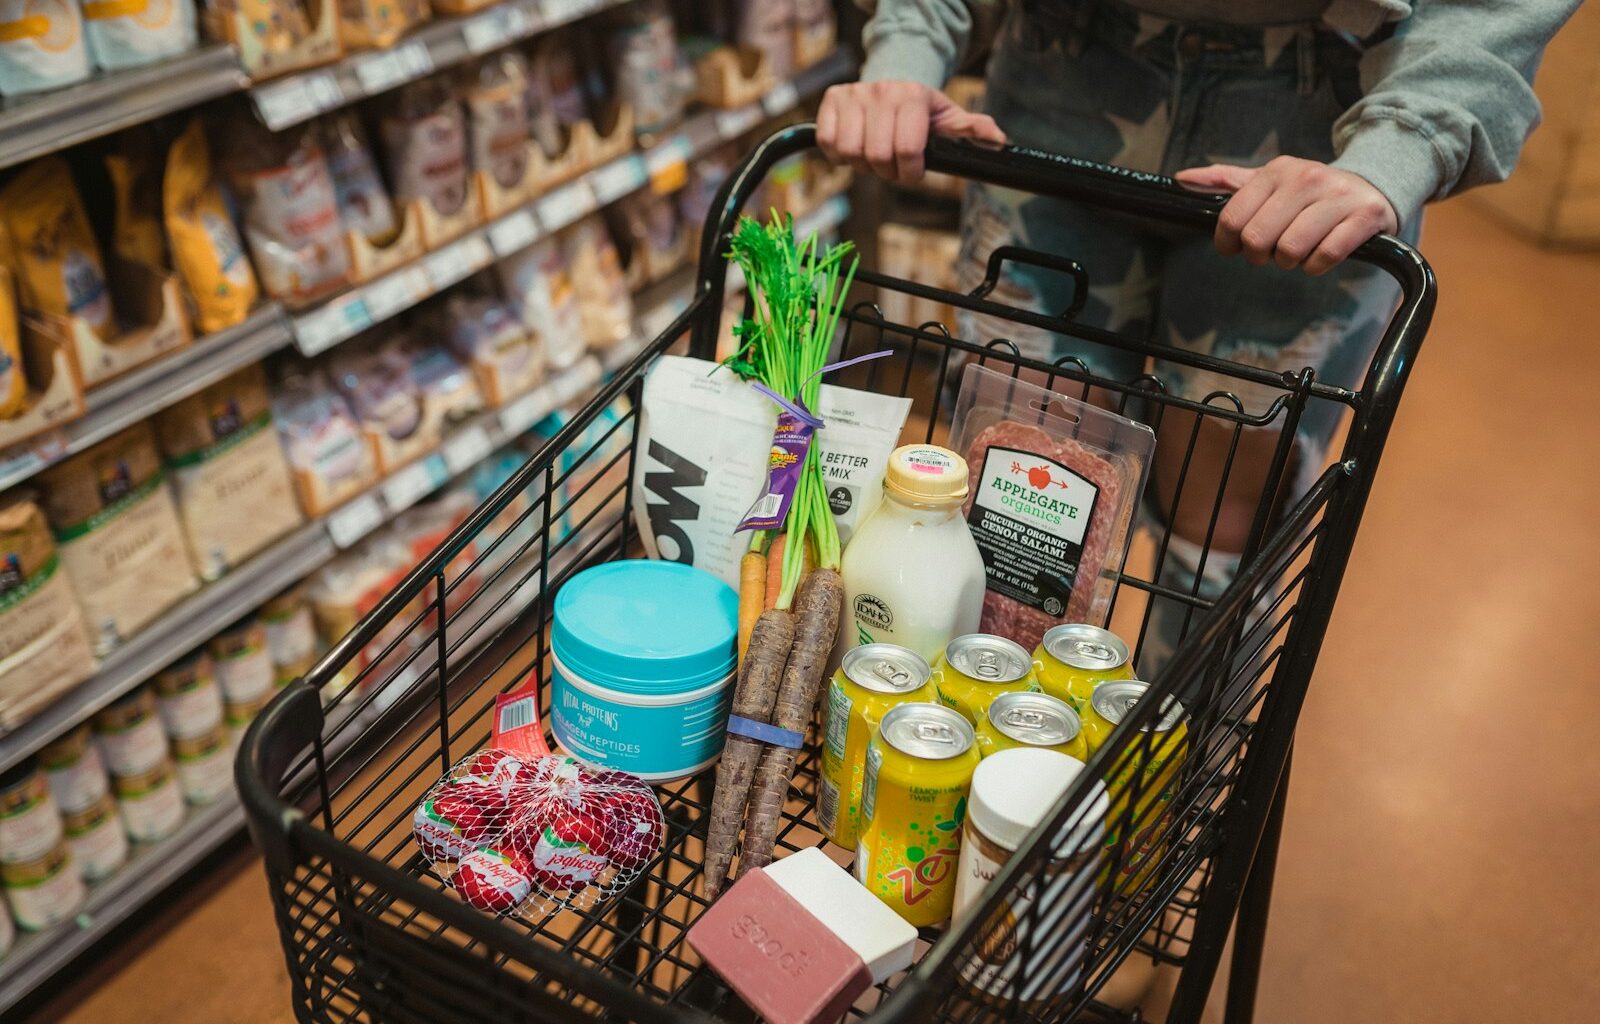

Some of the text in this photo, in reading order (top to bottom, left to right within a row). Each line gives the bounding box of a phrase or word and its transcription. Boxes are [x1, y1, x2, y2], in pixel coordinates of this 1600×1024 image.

[826, 452, 869, 468] BETTER
[829, 467, 851, 480] MIX
[837, 490, 846, 500] 2g
[992, 477, 1078, 519] APPLEGATE
[980, 520, 1019, 541] GENOA
[1020, 536, 1066, 559] SALAMI
[984, 512, 1026, 533] UNCURED
[1026, 529, 1067, 549] ORGANIC
[857, 602, 890, 624] IDAHO
[563, 688, 579, 710] VITAL
[581, 701, 619, 731] PROTEINS
[589, 735, 641, 754] PEPTIDES
[469, 854, 522, 888] Babybel
[546, 853, 607, 880] Babybel
